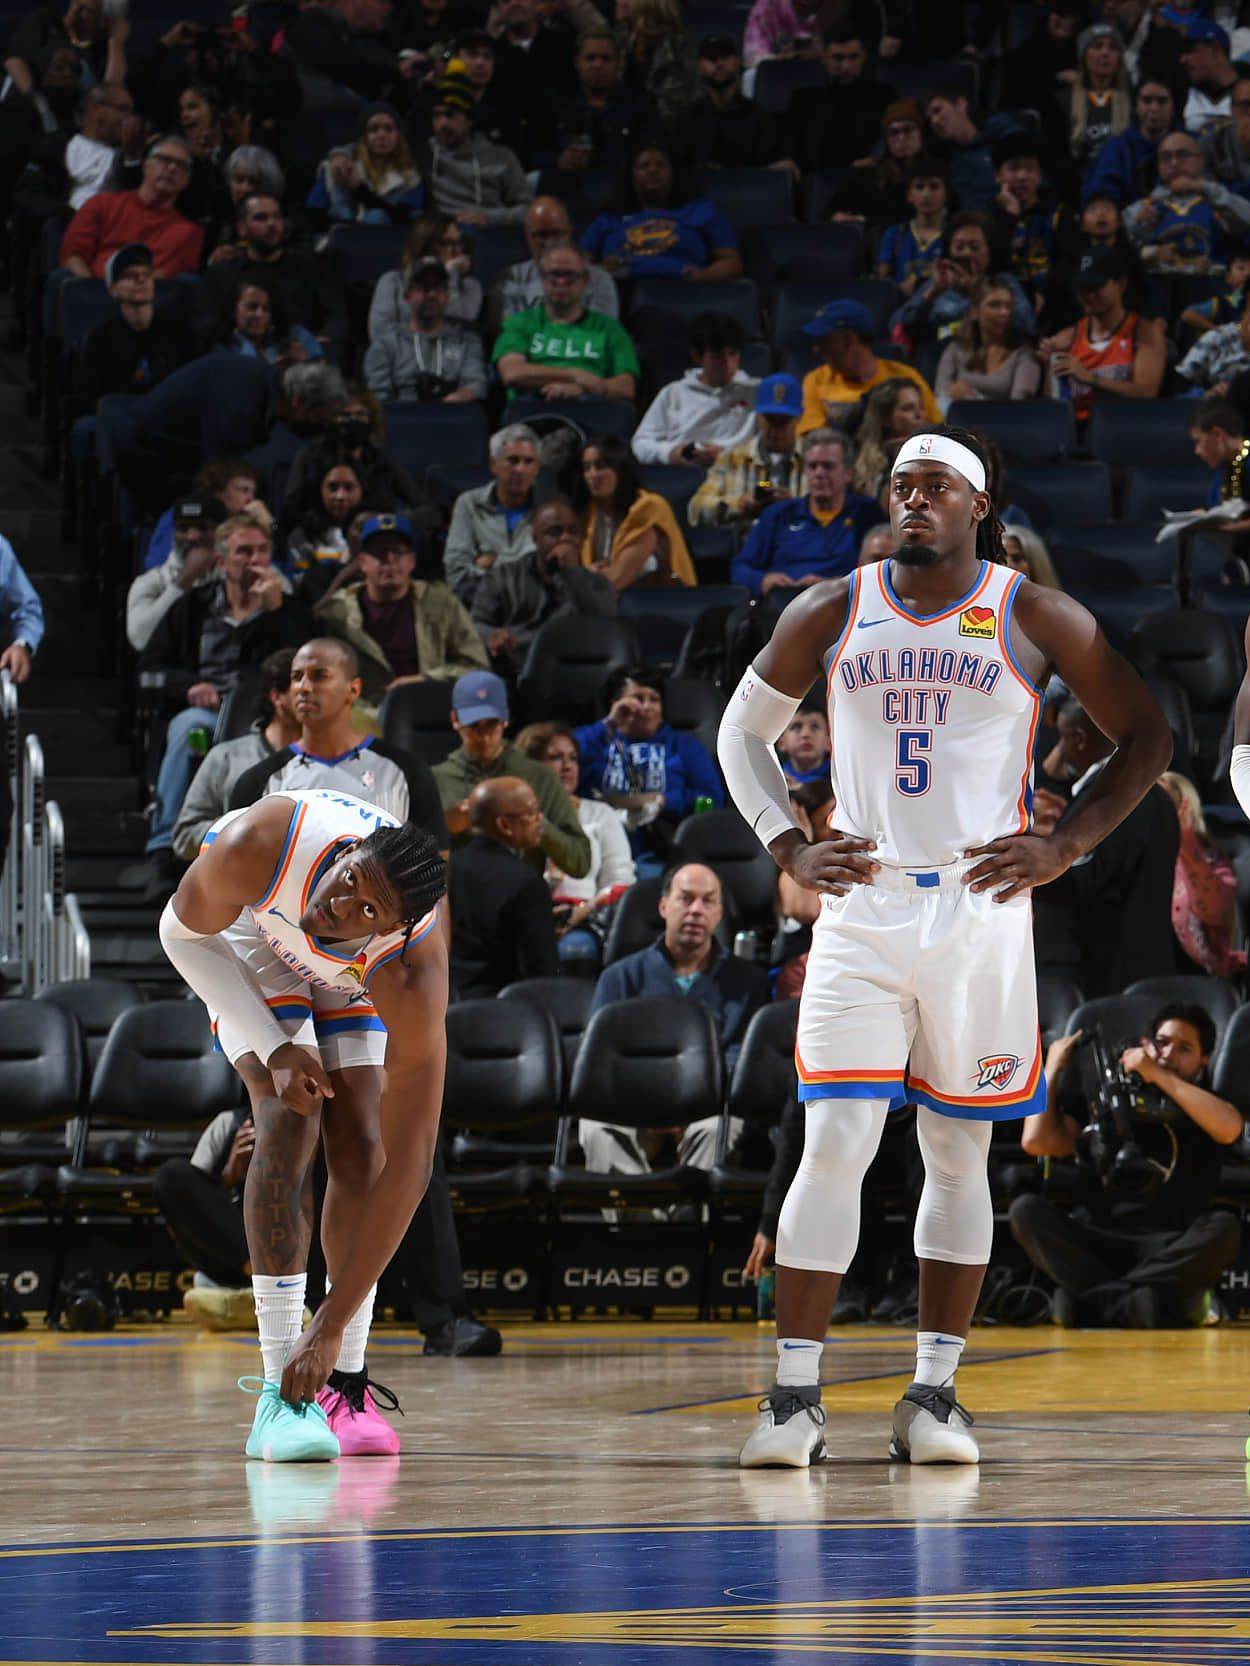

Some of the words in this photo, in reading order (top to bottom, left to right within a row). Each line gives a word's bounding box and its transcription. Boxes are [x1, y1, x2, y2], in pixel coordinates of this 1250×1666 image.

[530, 332, 600, 359] SELL
[839, 648, 1003, 696] OKLAHOMA
[883, 689, 951, 725] CITY
[895, 729, 933, 797] 5
[563, 1267, 660, 1288] CHASE
